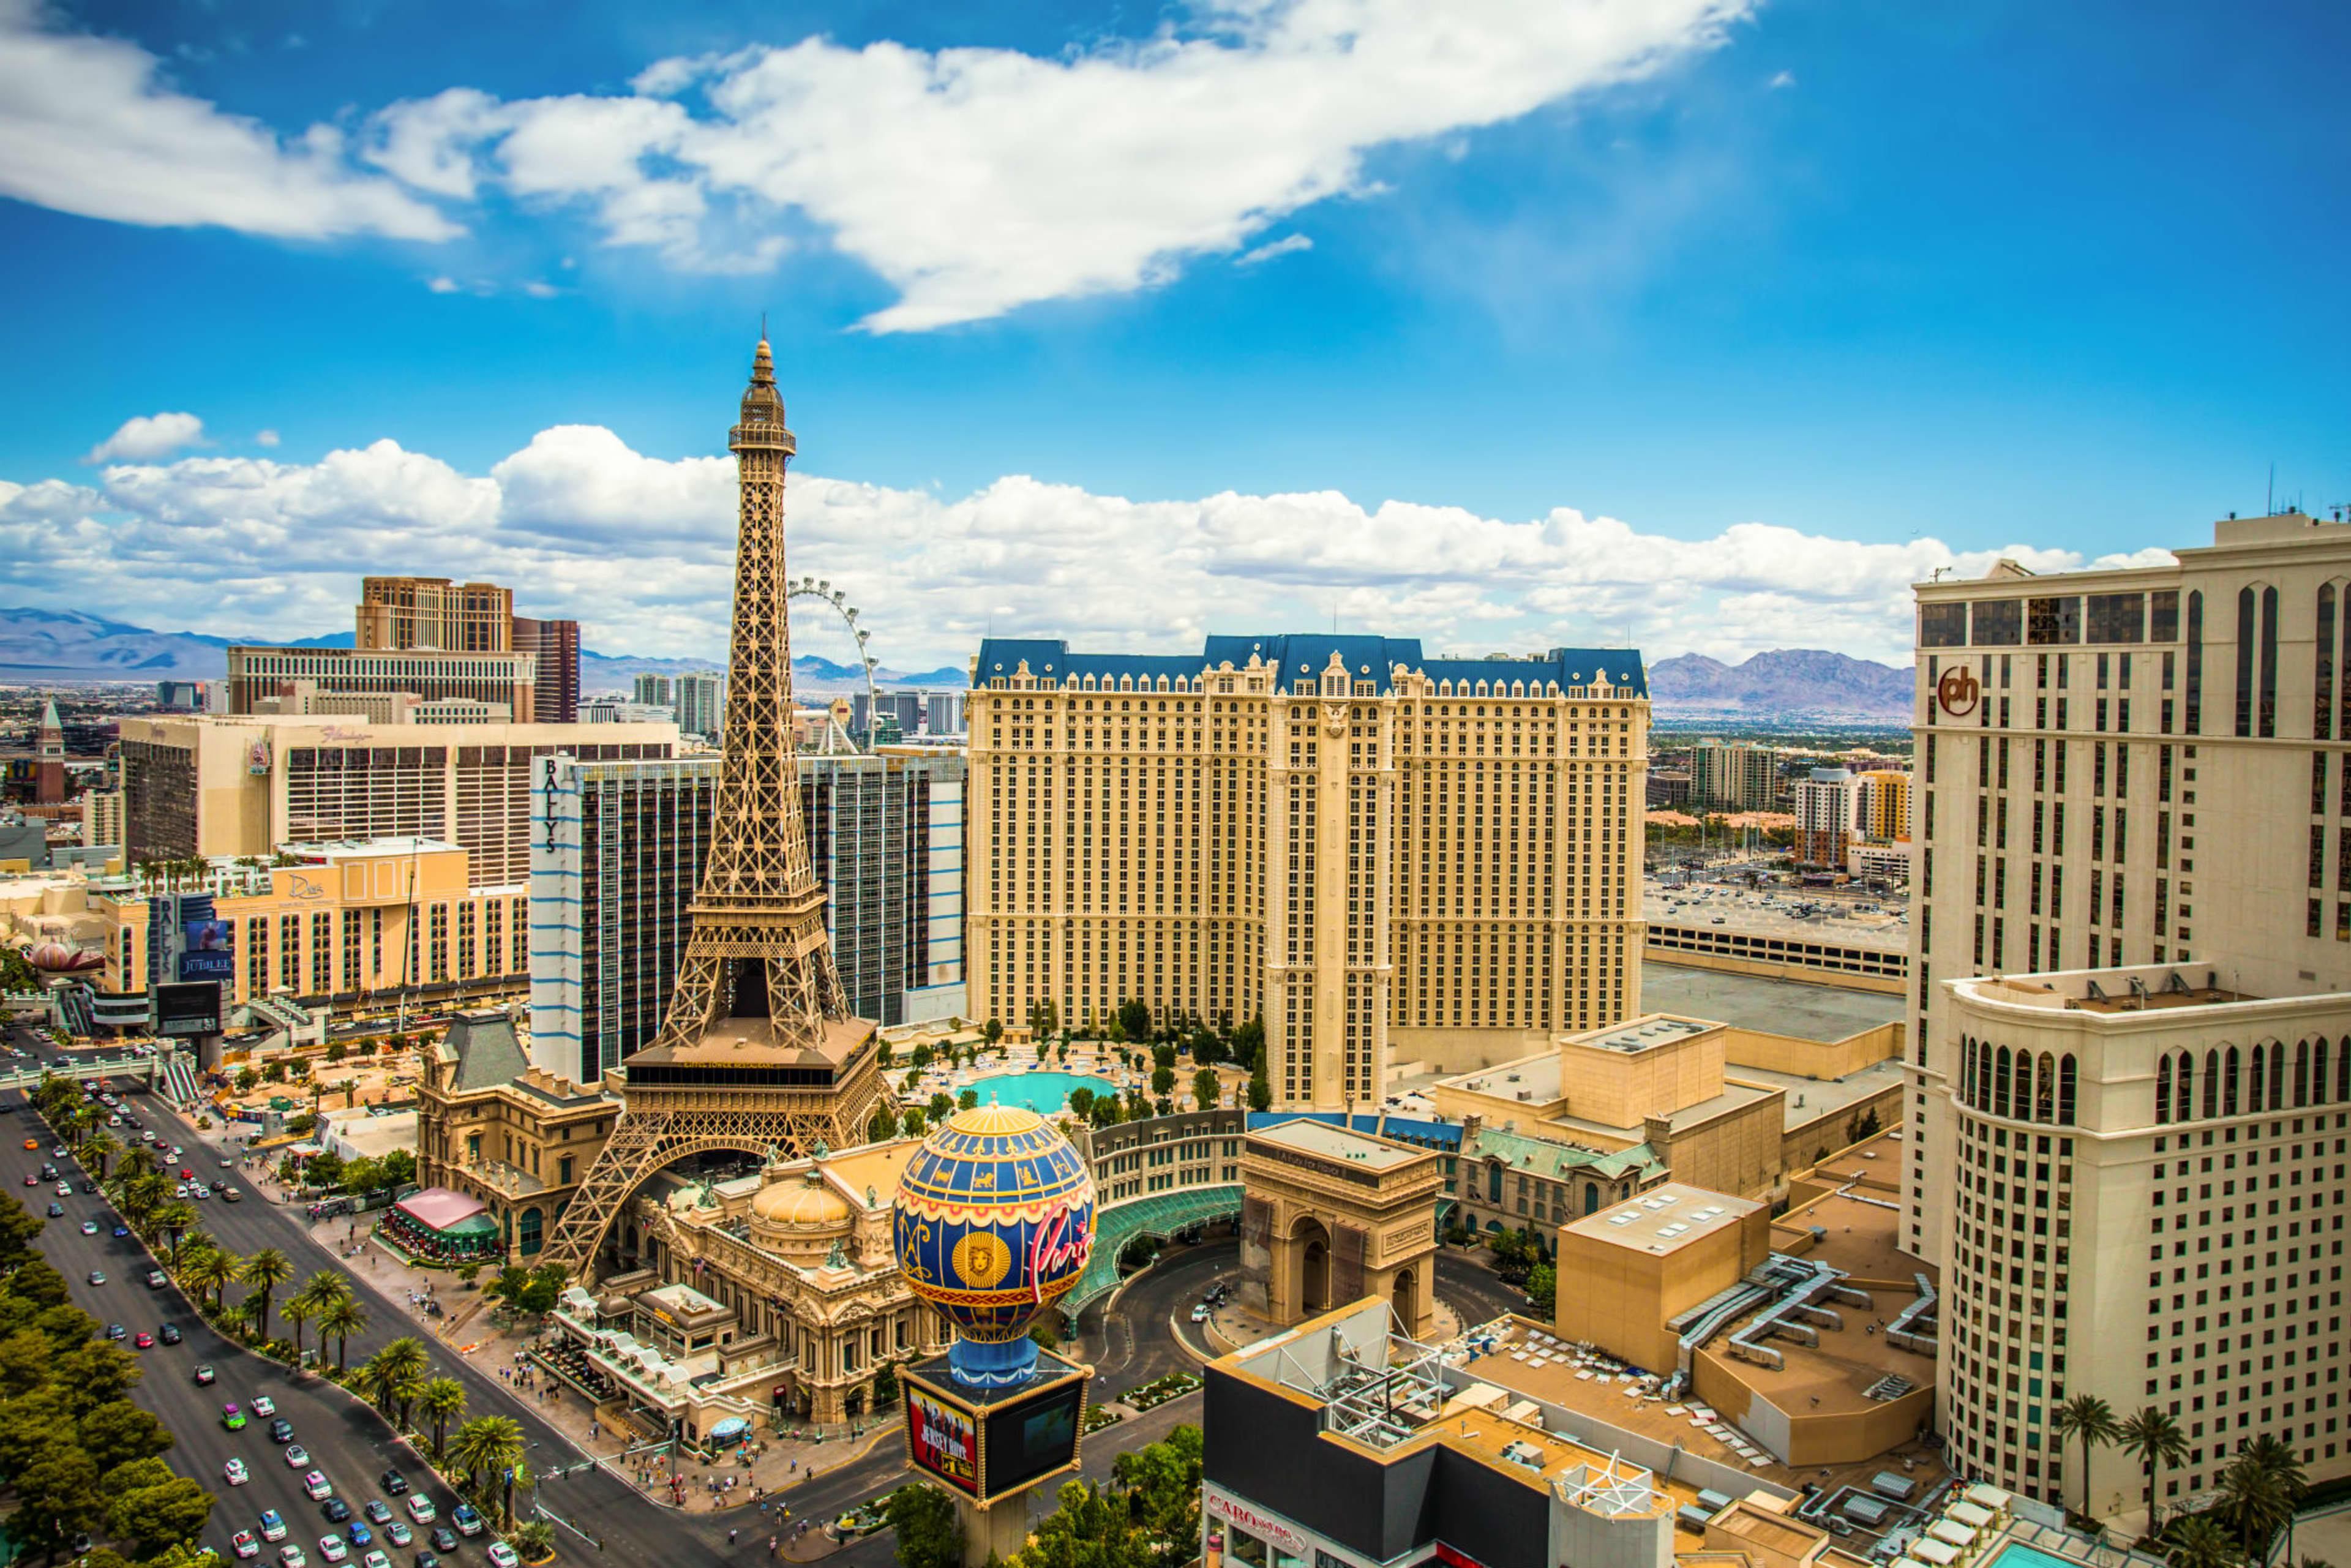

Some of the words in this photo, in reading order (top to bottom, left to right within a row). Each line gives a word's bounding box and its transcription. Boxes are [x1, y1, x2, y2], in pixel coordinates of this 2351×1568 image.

[282, 648, 351, 657] VENETIAN
[1029, 1202, 1096, 1304] Paris
[921, 1424, 948, 1454] JERSEY
[1210, 1495, 1256, 1527] CABO
